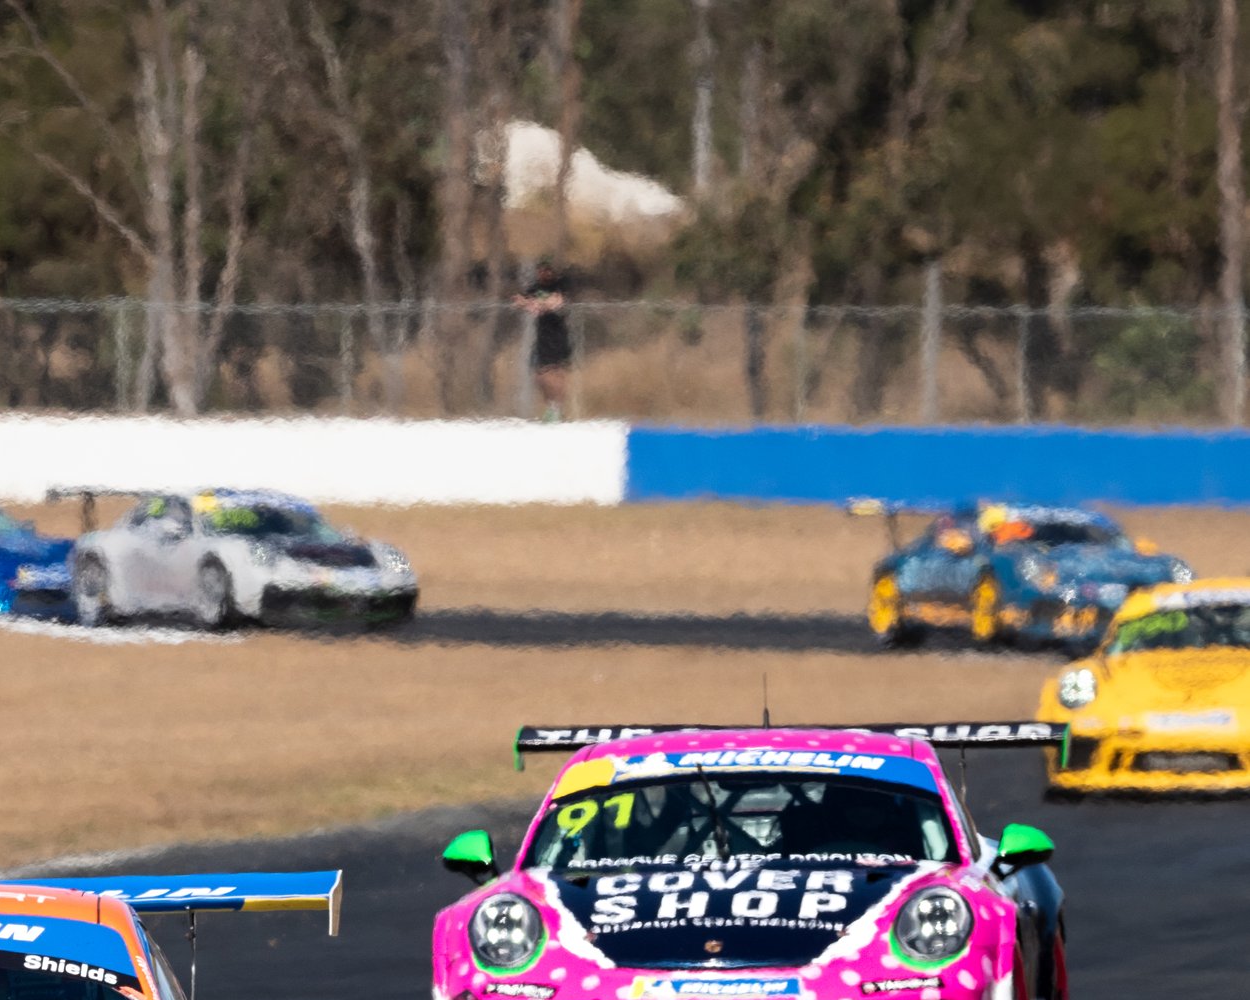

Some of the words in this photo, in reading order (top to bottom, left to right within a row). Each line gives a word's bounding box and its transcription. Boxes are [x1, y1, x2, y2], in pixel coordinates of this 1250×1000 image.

[678, 750, 886, 770] MICHELIN
[557, 793, 636, 837] 91
[596, 869, 854, 896] COVER
[590, 889, 847, 924] SHOP
[23, 954, 118, 985] Shields
